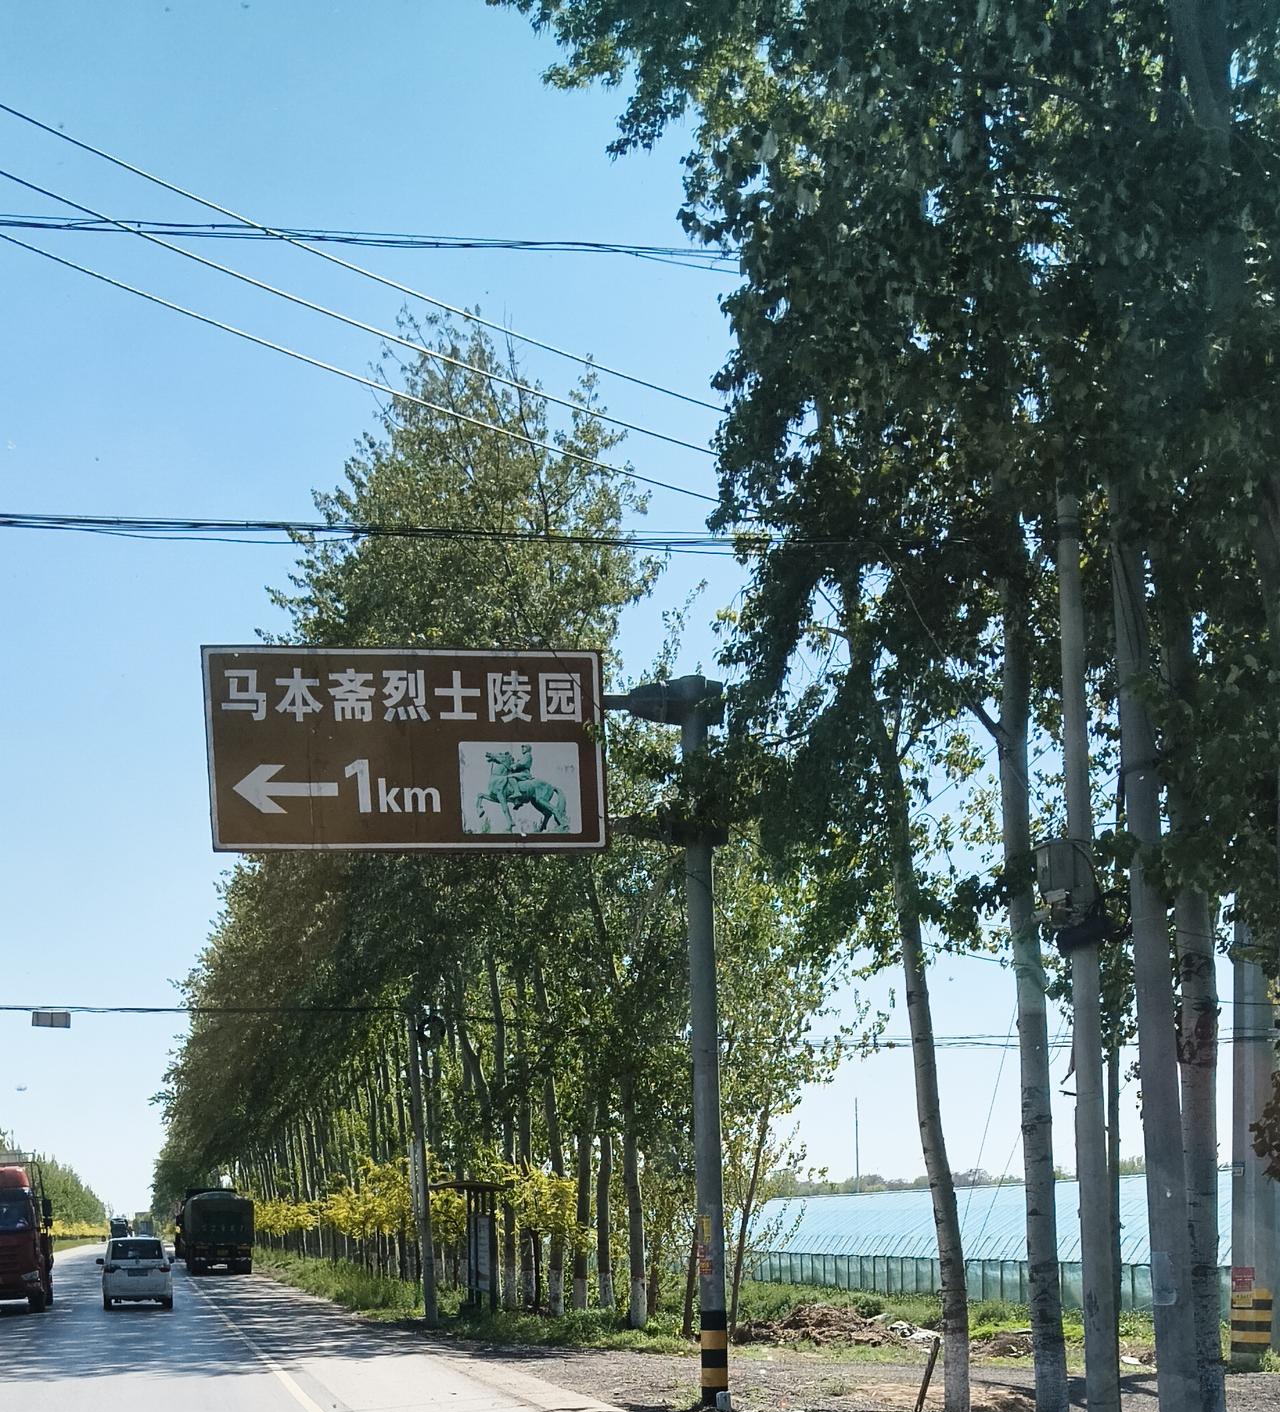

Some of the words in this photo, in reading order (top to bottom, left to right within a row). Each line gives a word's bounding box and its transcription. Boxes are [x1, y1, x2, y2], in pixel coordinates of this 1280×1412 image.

[221, 668, 582, 723] 马本斋烈士陵园
[344, 759, 441, 813] 1km
